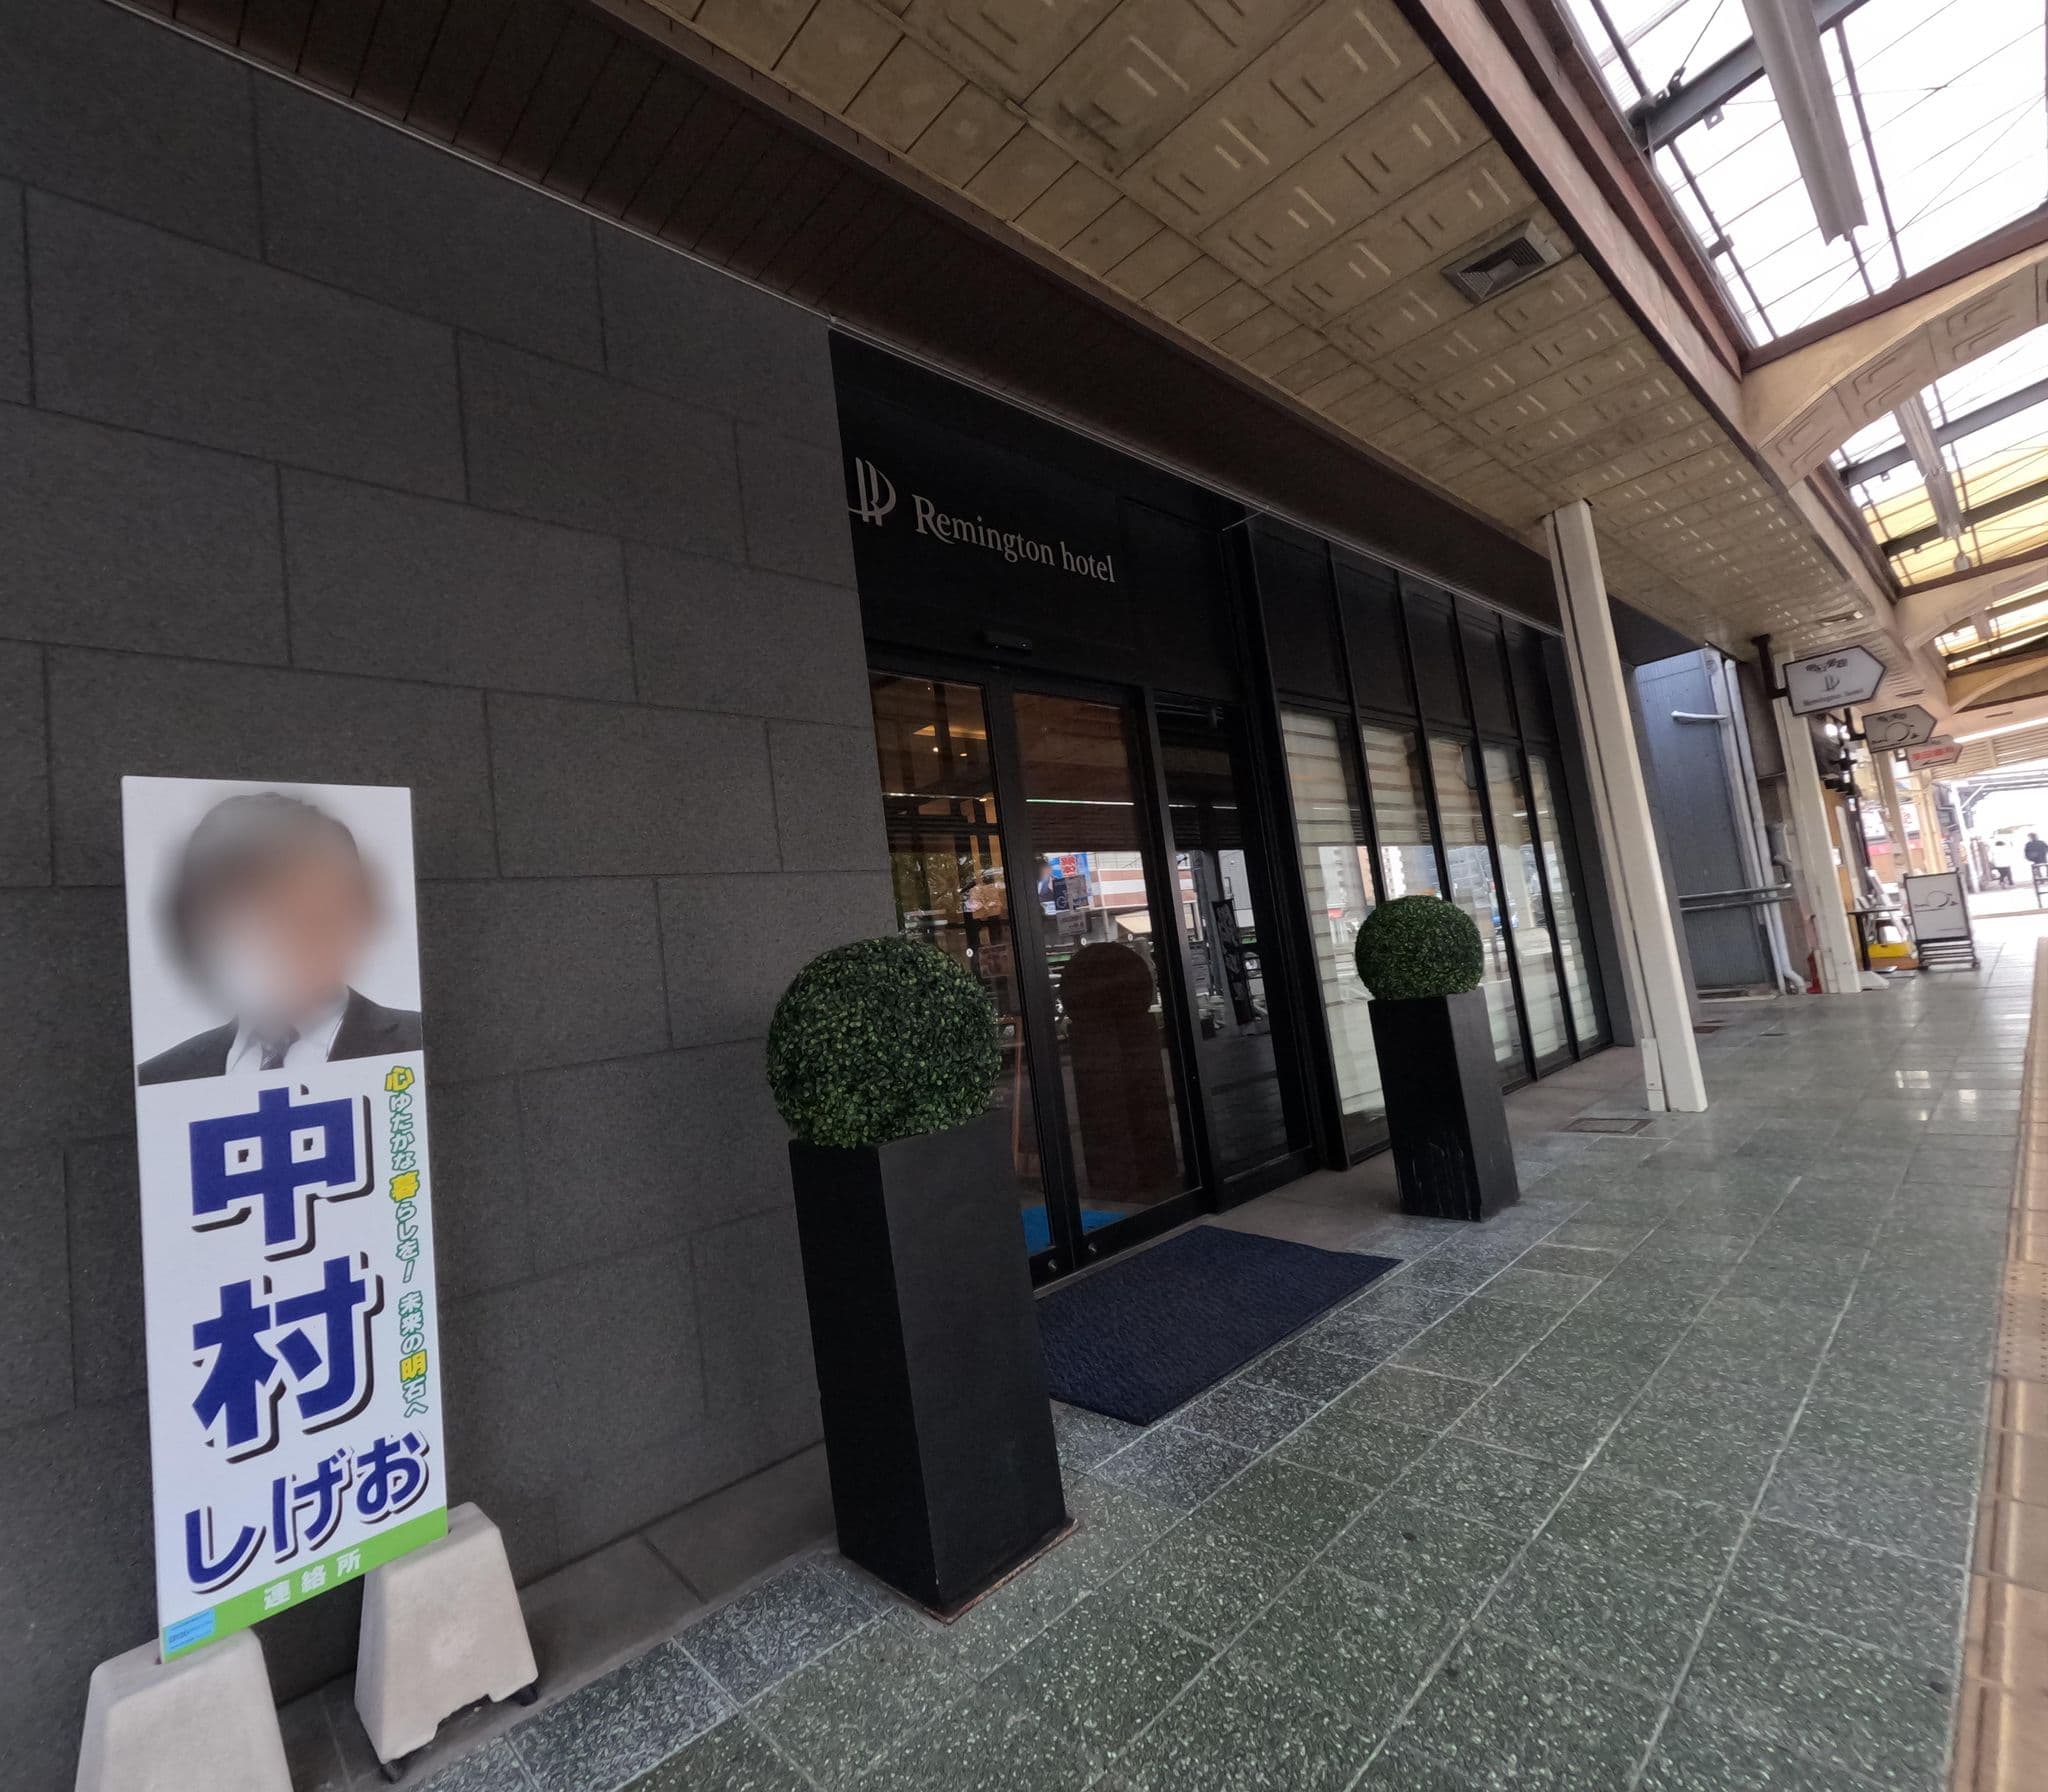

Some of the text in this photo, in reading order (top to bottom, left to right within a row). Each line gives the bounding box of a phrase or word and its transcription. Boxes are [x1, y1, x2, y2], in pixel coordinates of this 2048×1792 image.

[911, 494, 1116, 583] Remington hotel
[188, 1086, 370, 1456] 中村
[398, 1290, 429, 1418] 未来の明石へ
[184, 1434, 426, 1590] しげお
[263, 1549, 362, 1611] 連絡所
